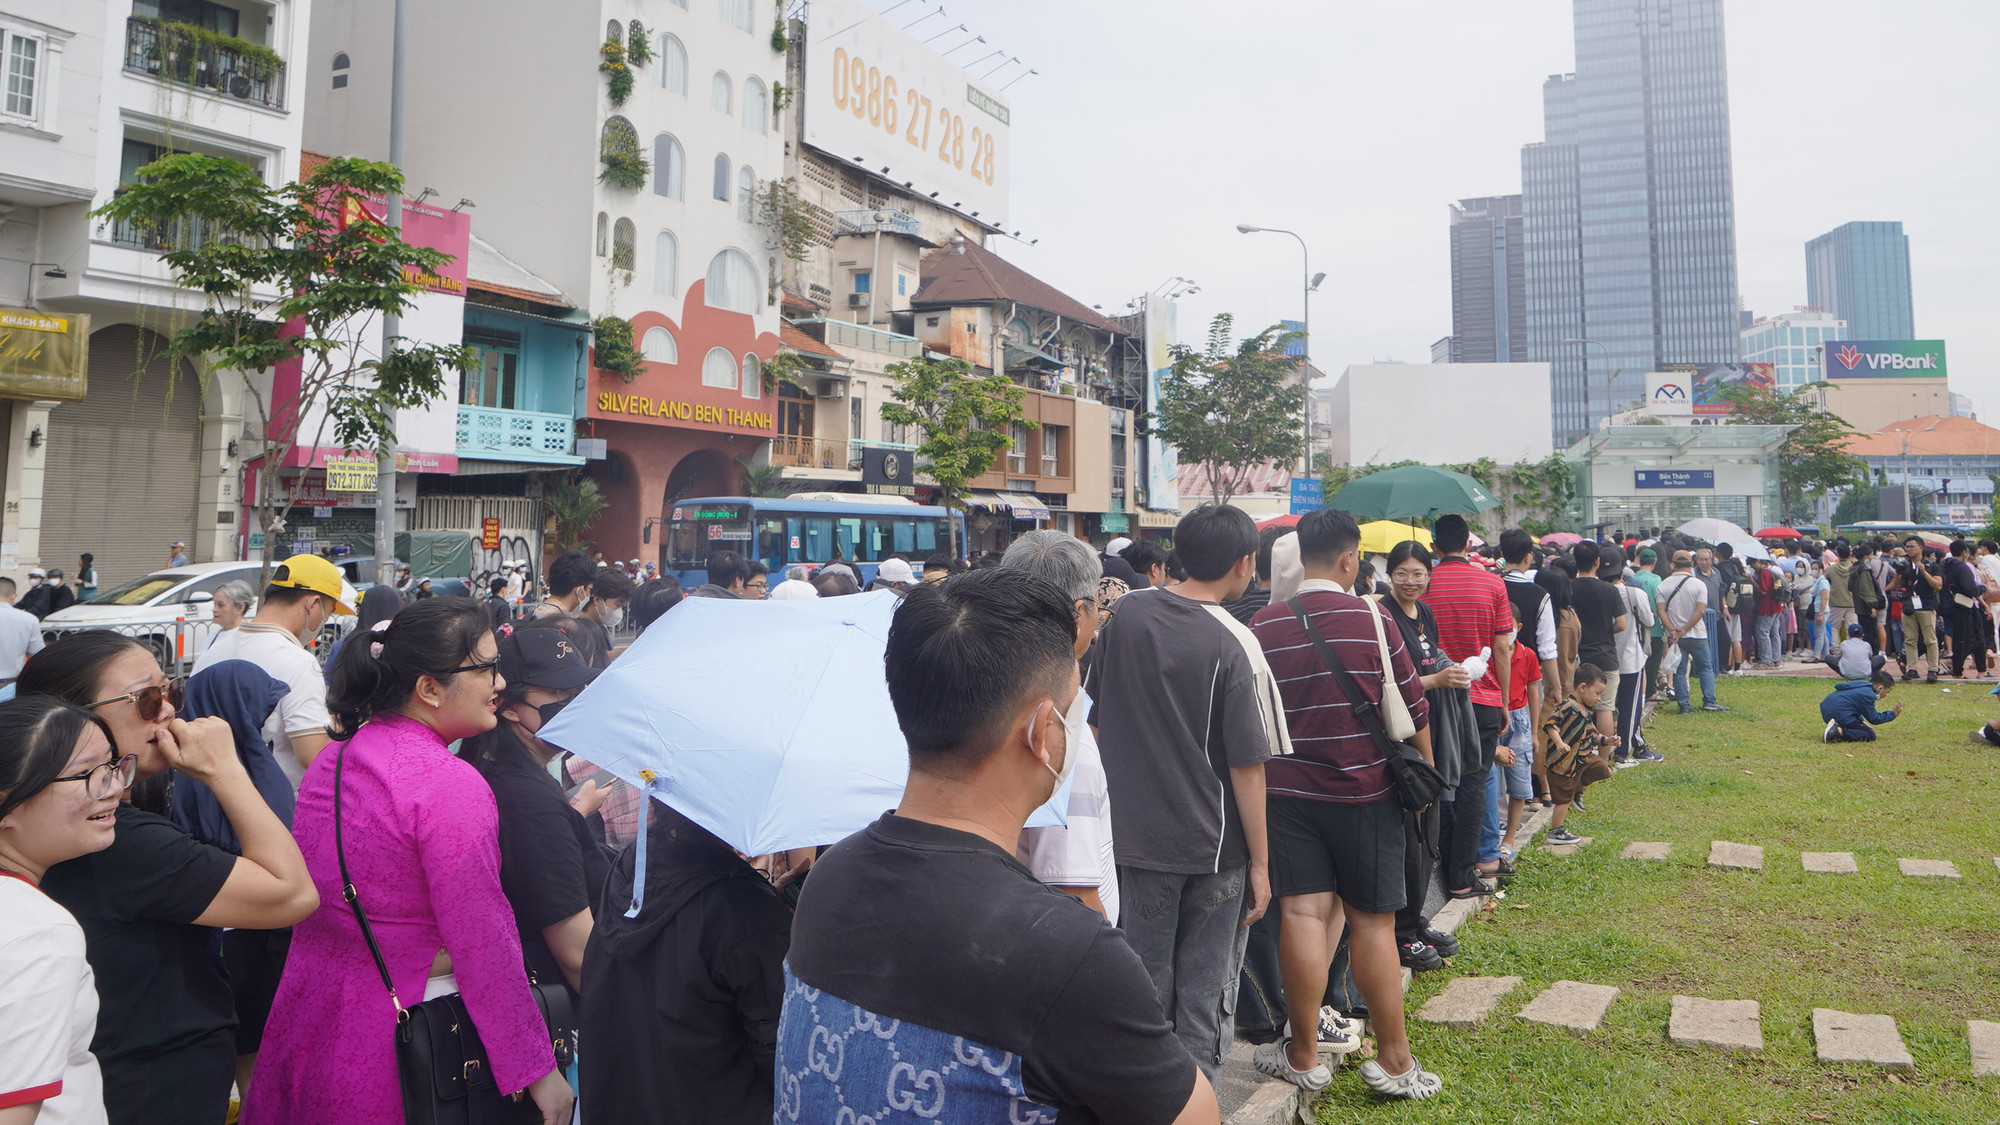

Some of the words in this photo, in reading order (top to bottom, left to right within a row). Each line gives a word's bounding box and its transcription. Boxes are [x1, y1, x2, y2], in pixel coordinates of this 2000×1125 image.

[832, 46, 898, 136] 0986
[905, 88, 932, 152] 27
[938, 107, 964, 171] 28
[971, 126, 994, 187] 28
[1866, 352, 1938, 370] VPBank
[598, 391, 692, 420] SILVERLAND
[695, 404, 722, 424] BEN
[726, 408, 773, 429] THANH
[328, 472, 377, 489] 0972.377.039
[673, 509, 682, 518] 56
[709, 525, 722, 539] 56
[791, 537, 798, 547] 56
